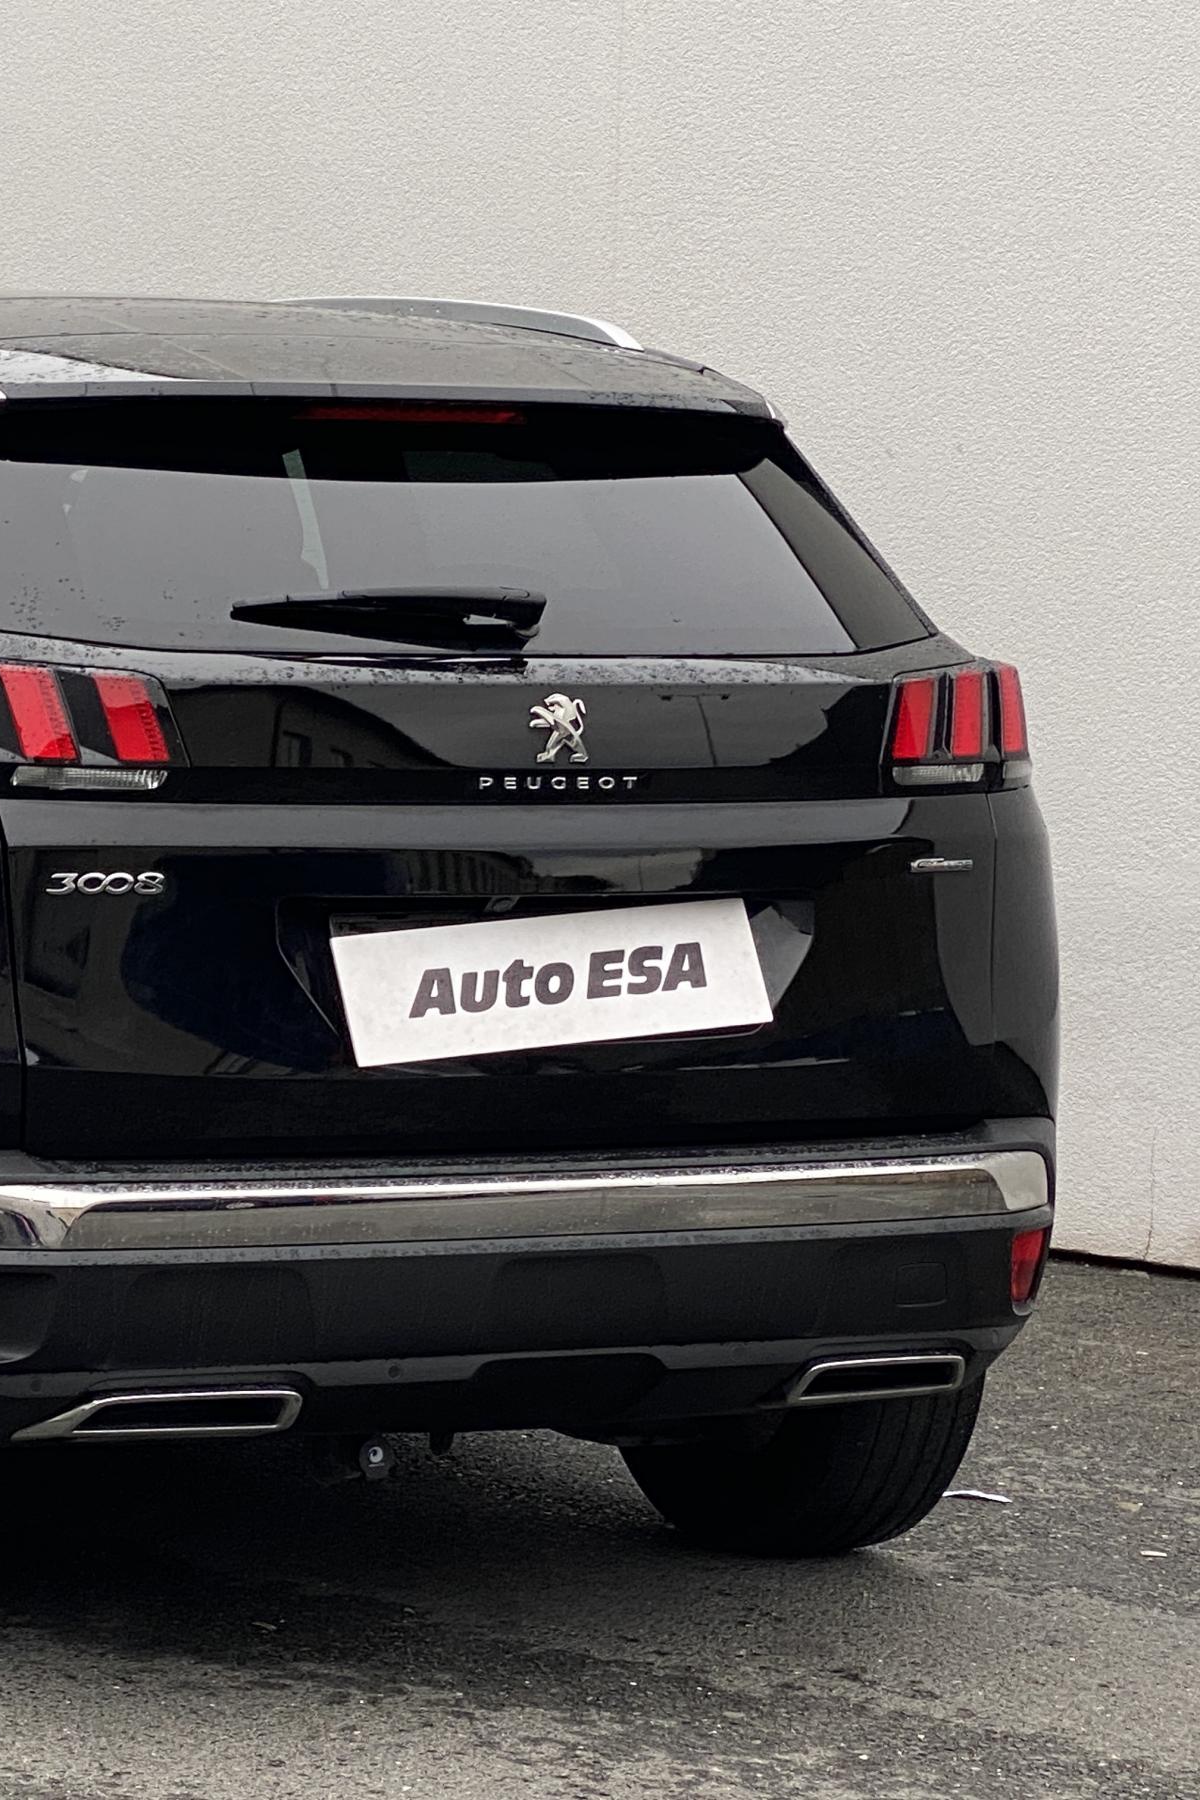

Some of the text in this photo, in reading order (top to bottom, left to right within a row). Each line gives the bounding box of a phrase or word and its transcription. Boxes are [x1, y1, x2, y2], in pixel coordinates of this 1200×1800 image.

[478, 776, 638, 790] PEUGEOT
[45, 871, 165, 896] 3008
[408, 941, 708, 1019] Auto ESA
